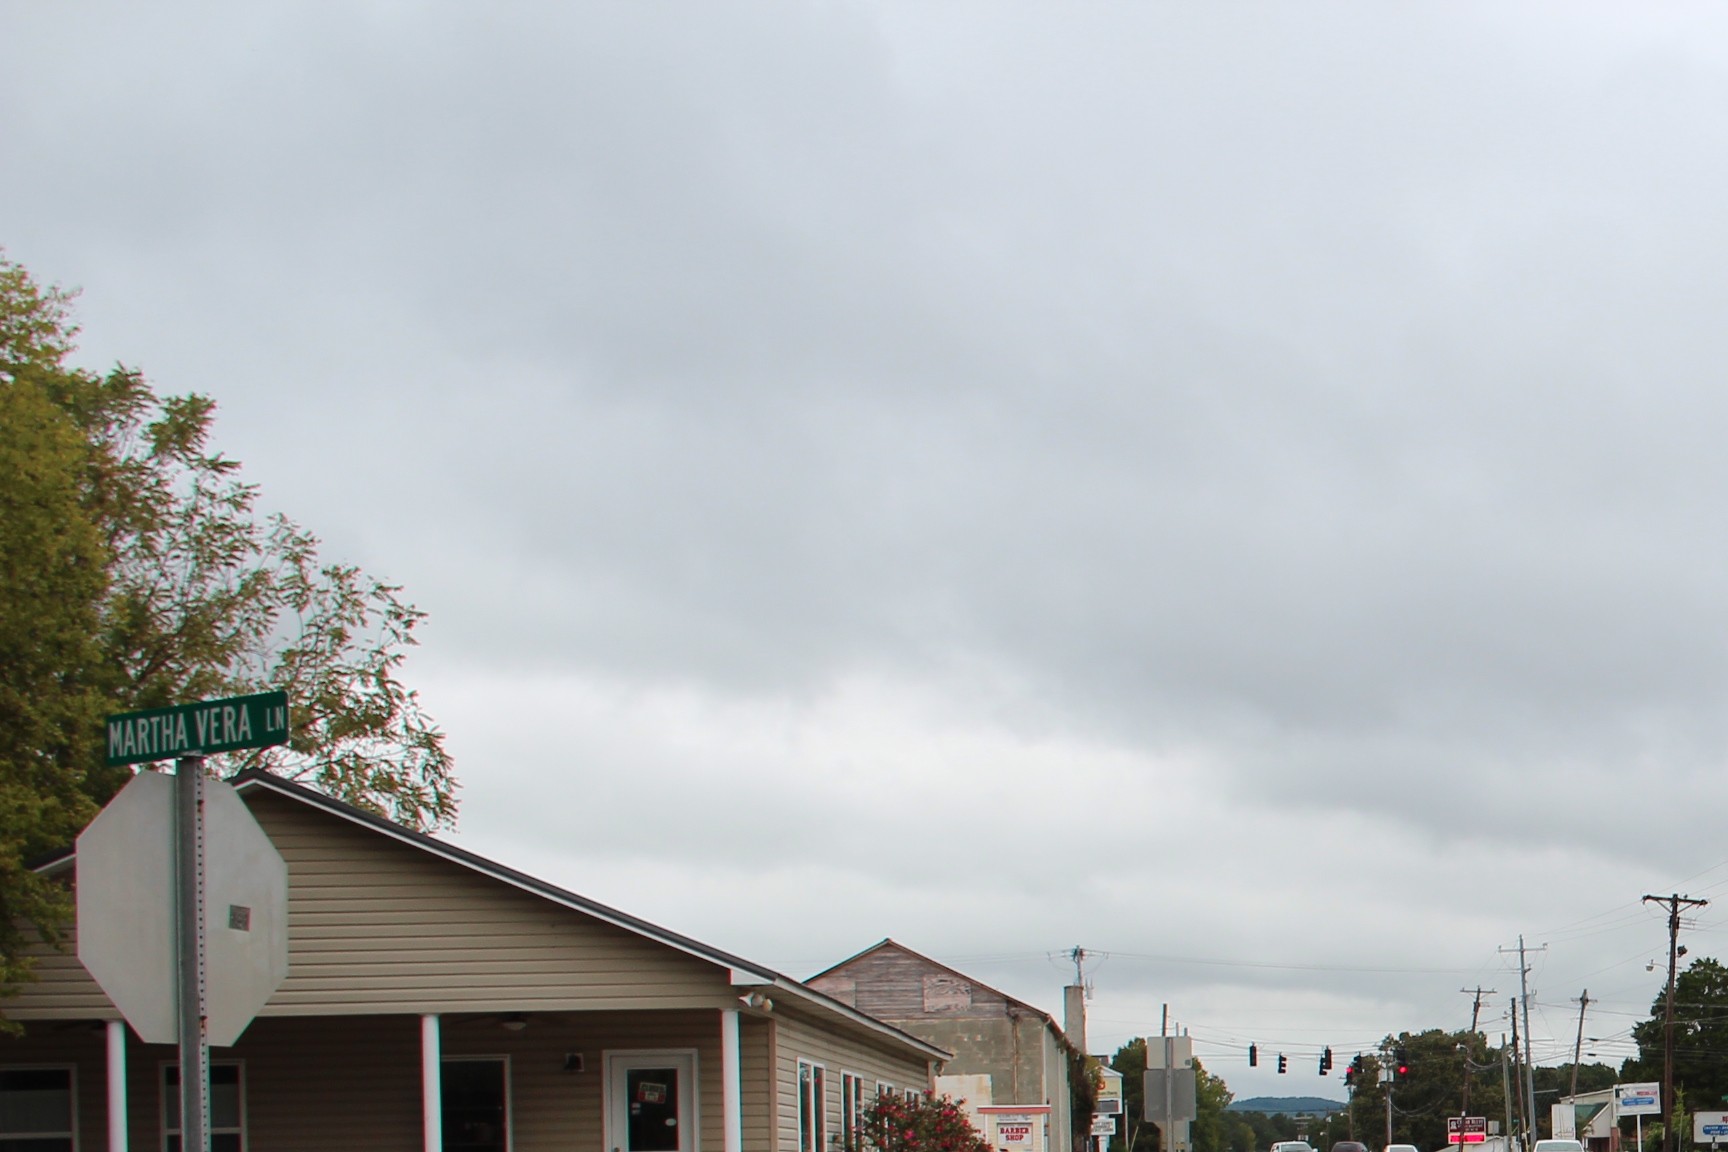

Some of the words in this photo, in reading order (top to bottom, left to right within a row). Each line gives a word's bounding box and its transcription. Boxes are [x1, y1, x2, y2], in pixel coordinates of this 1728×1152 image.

[108, 712, 189, 758] MARTHA
[194, 704, 252, 747] VERA
[265, 706, 285, 732] LN
[1000, 1127, 1029, 1135] BARBER
[1005, 1134, 1024, 1142] SHOP
